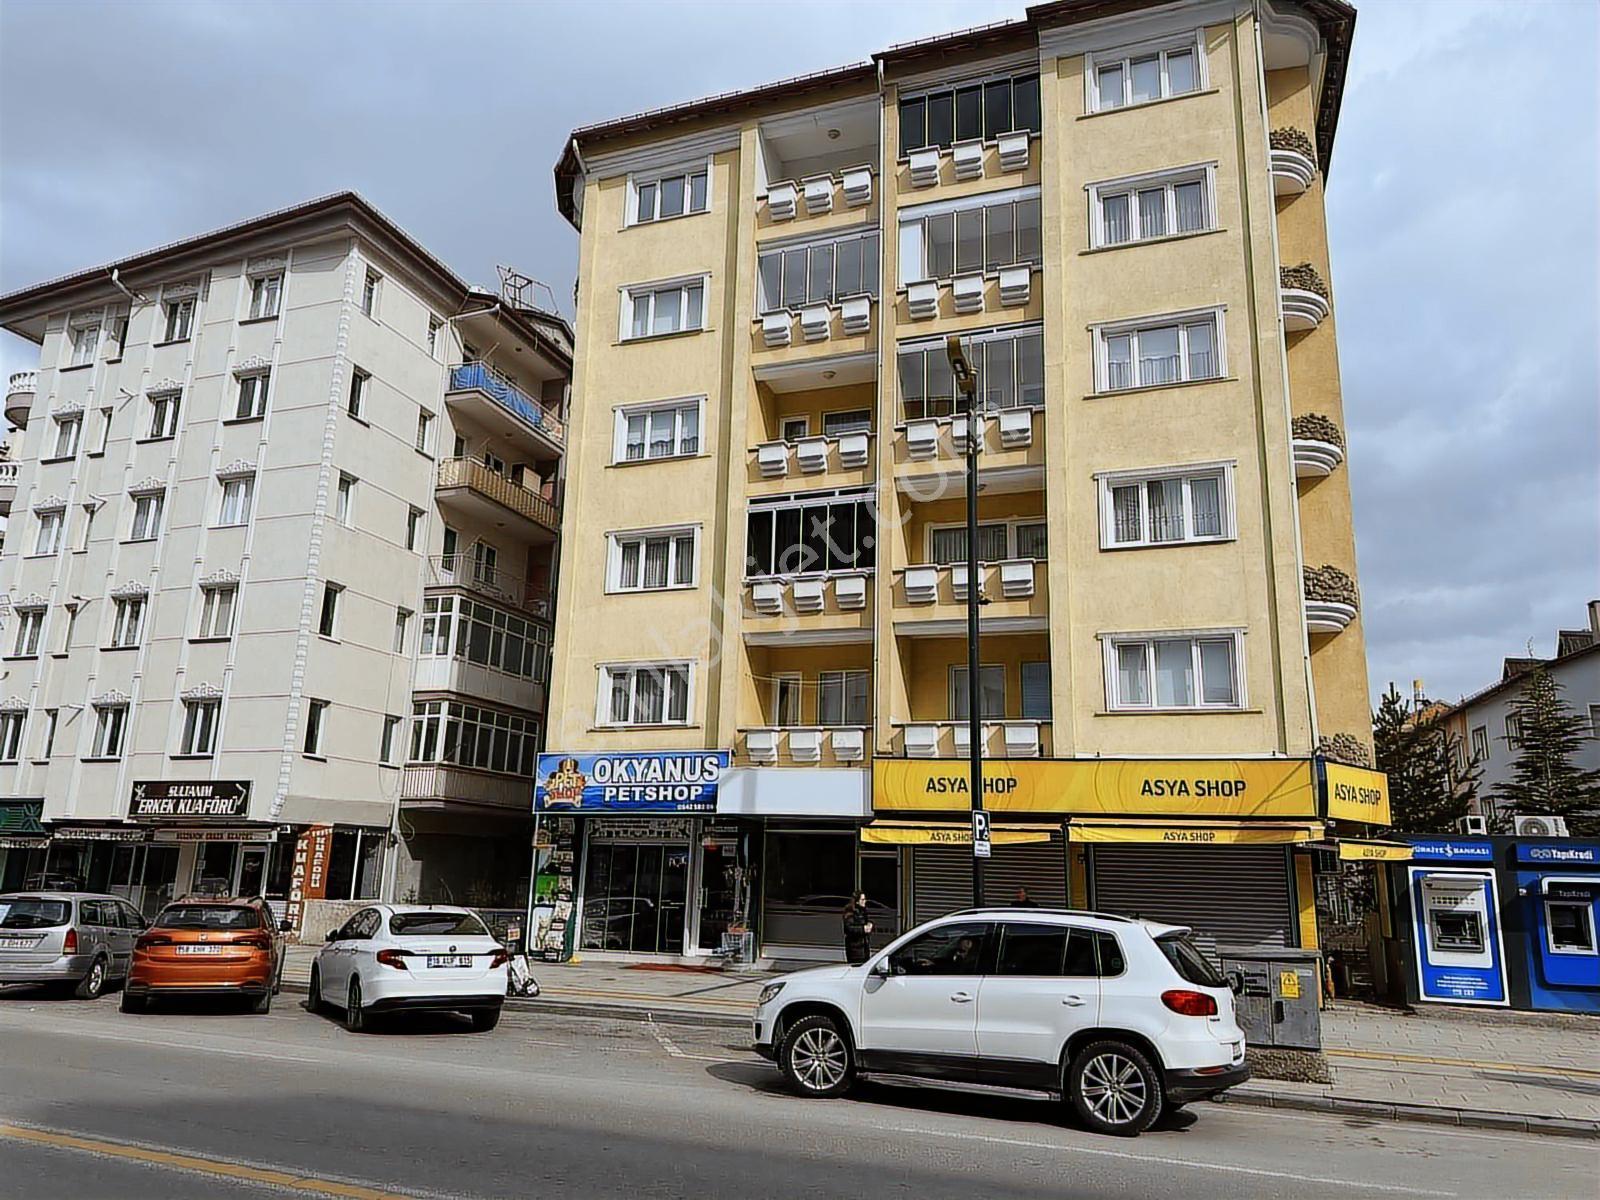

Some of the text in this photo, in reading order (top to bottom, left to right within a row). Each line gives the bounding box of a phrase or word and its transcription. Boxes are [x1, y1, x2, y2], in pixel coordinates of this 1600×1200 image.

[594, 757, 719, 782] OKYANUS
[604, 785, 703, 801] PETSHOP
[926, 777, 1018, 794] ASYA HOP
[1141, 779, 1247, 797] ASYA SHOP
[1334, 783, 1381, 806] ASYA SHOP
[137, 795, 238, 815] ERKEK KUAFÖRÜ
[975, 814, 985, 839] P
[930, 832, 952, 842] ASYA
[1163, 831, 1216, 842] ASYA SHOP
